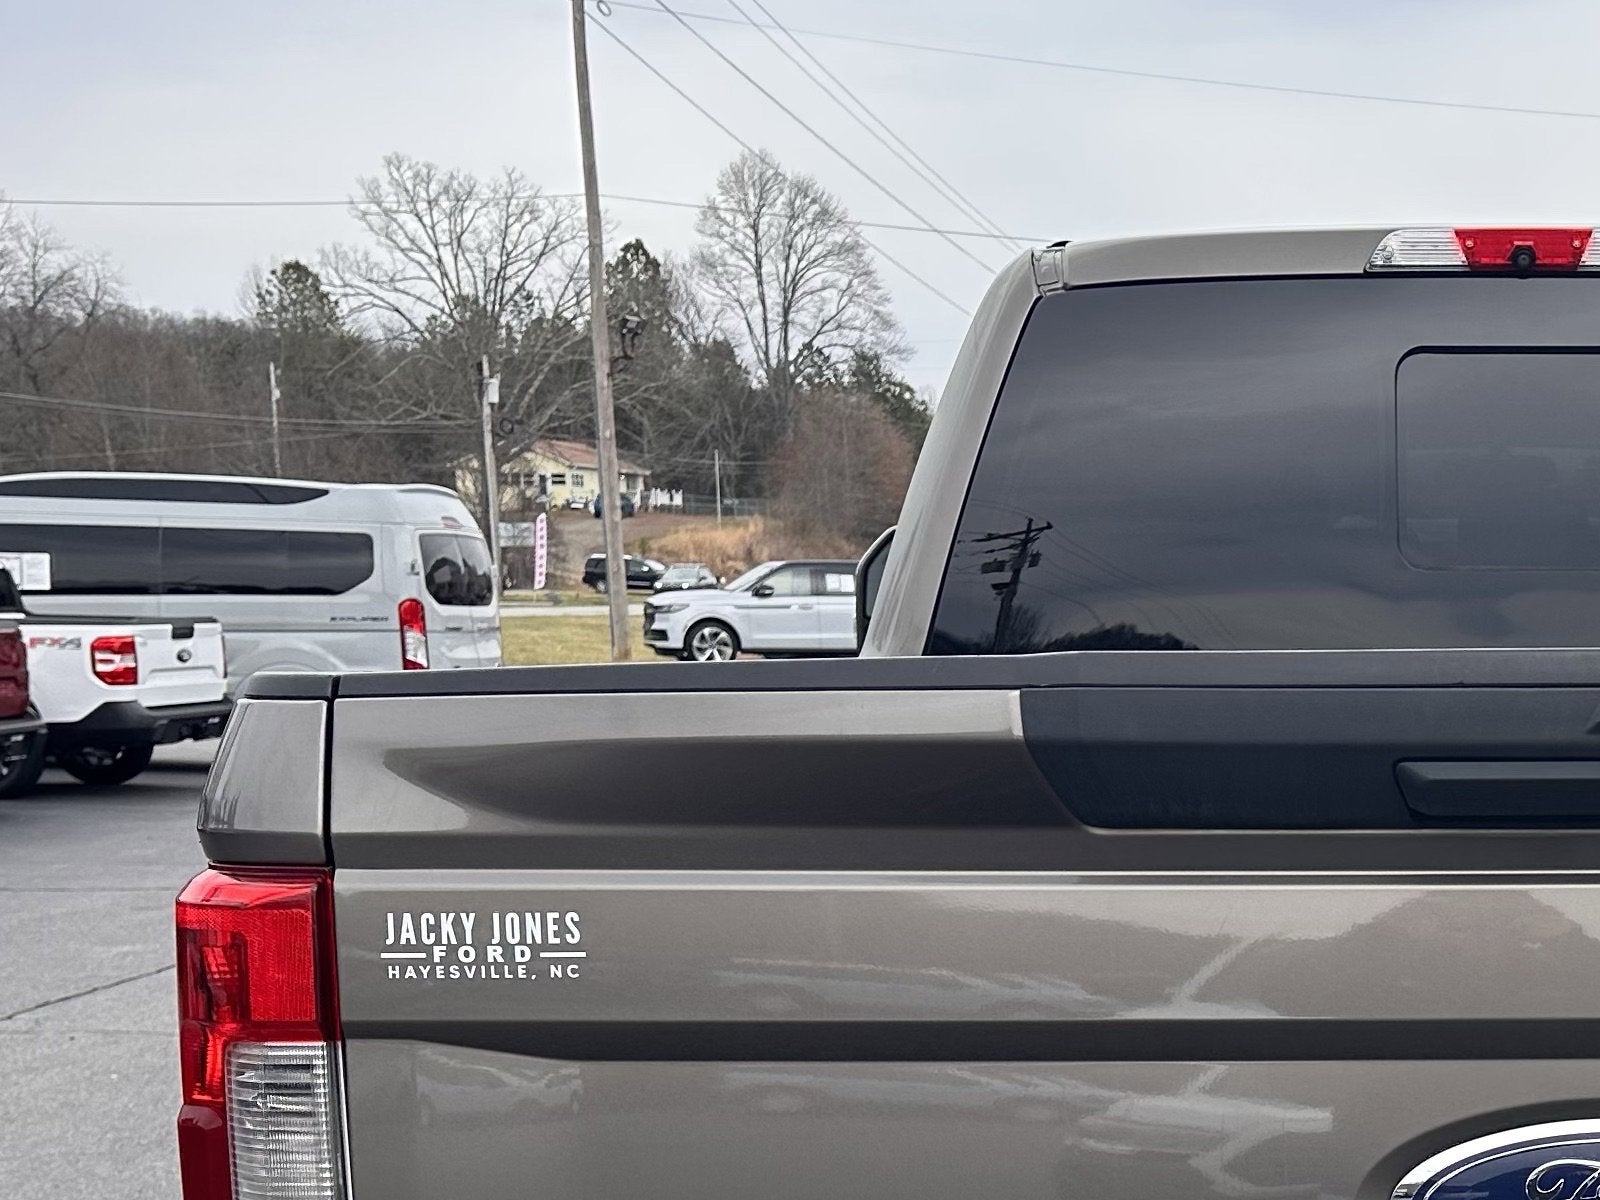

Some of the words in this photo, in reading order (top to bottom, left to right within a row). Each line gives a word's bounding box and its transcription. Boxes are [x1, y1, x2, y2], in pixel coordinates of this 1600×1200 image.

[386, 912, 476, 945] JACKY
[491, 911, 581, 945] JONES
[433, 945, 532, 963] FORD
[388, 965, 537, 980] HAYESVILLE,
[550, 964, 580, 978] NC
